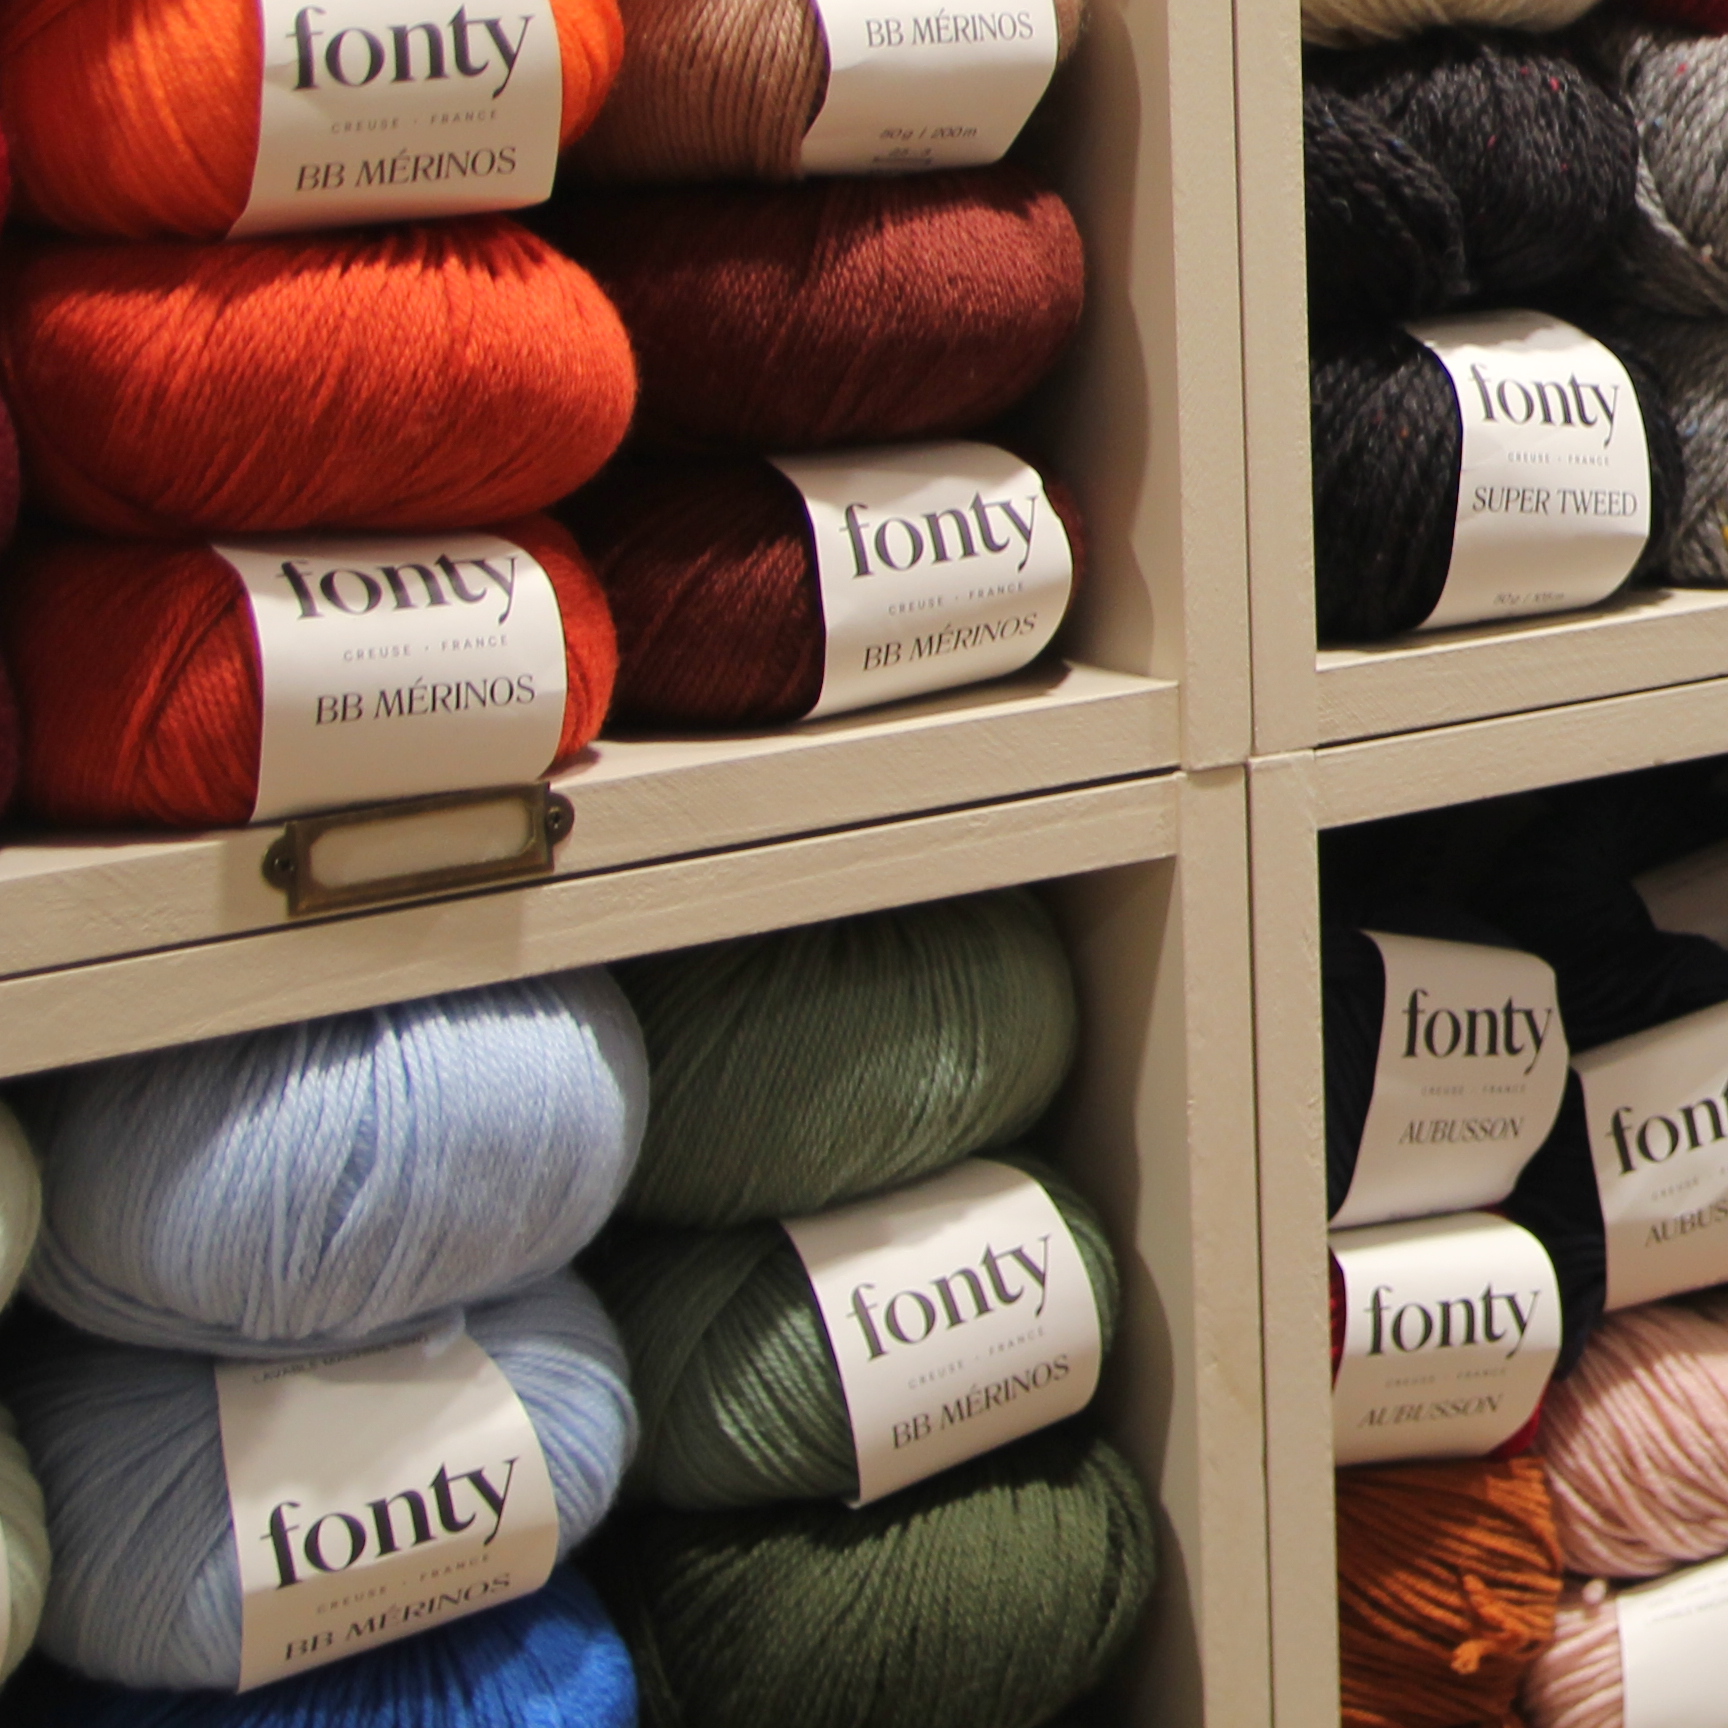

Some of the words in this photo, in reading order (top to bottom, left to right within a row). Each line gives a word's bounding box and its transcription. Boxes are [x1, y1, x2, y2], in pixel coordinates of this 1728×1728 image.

[286, 3, 536, 100] fonty
[865, 18, 904, 48] BB
[911, 9, 1034, 45] MÉRINOS
[331, 117, 399, 134] CREUSE
[430, 109, 498, 126] FRANCE
[296, 163, 345, 192] BB
[355, 147, 517, 188] MÉRINOS
[1469, 363, 1620, 448] fonty
[1507, 451, 1549, 465] CREUSE
[1568, 453, 1610, 467] FRANCE
[1472, 487, 1549, 515] SUPER
[1557, 488, 1638, 516] TWEED
[839, 491, 1039, 579] fonty
[276, 553, 519, 626] fonty
[888, 597, 945, 616] CREUSE
[969, 582, 1025, 600] FRANCE
[343, 644, 412, 662] CREUSE
[441, 634, 509, 652] FRANCE
[863, 643, 901, 671] BB
[909, 615, 1037, 662] MÉRINOS
[316, 694, 363, 726] BB
[374, 675, 536, 721] MÉRINOS
[1402, 987, 1554, 1075] fonty
[1398, 1117, 1524, 1146] AUBUSSON
[846, 1233, 1052, 1361] fonty
[1363, 1282, 1541, 1360] fonty
[908, 1359, 965, 1390] CREUSE
[988, 1326, 1046, 1357] FRANCE
[891, 1415, 932, 1451] BB
[939, 1355, 1070, 1431] MÉRINOS
[260, 1457, 519, 1590] fonty
[317, 1585, 388, 1615] CREUSE
[419, 1553, 491, 1583] FRANCE
[285, 1632, 334, 1662] BB
